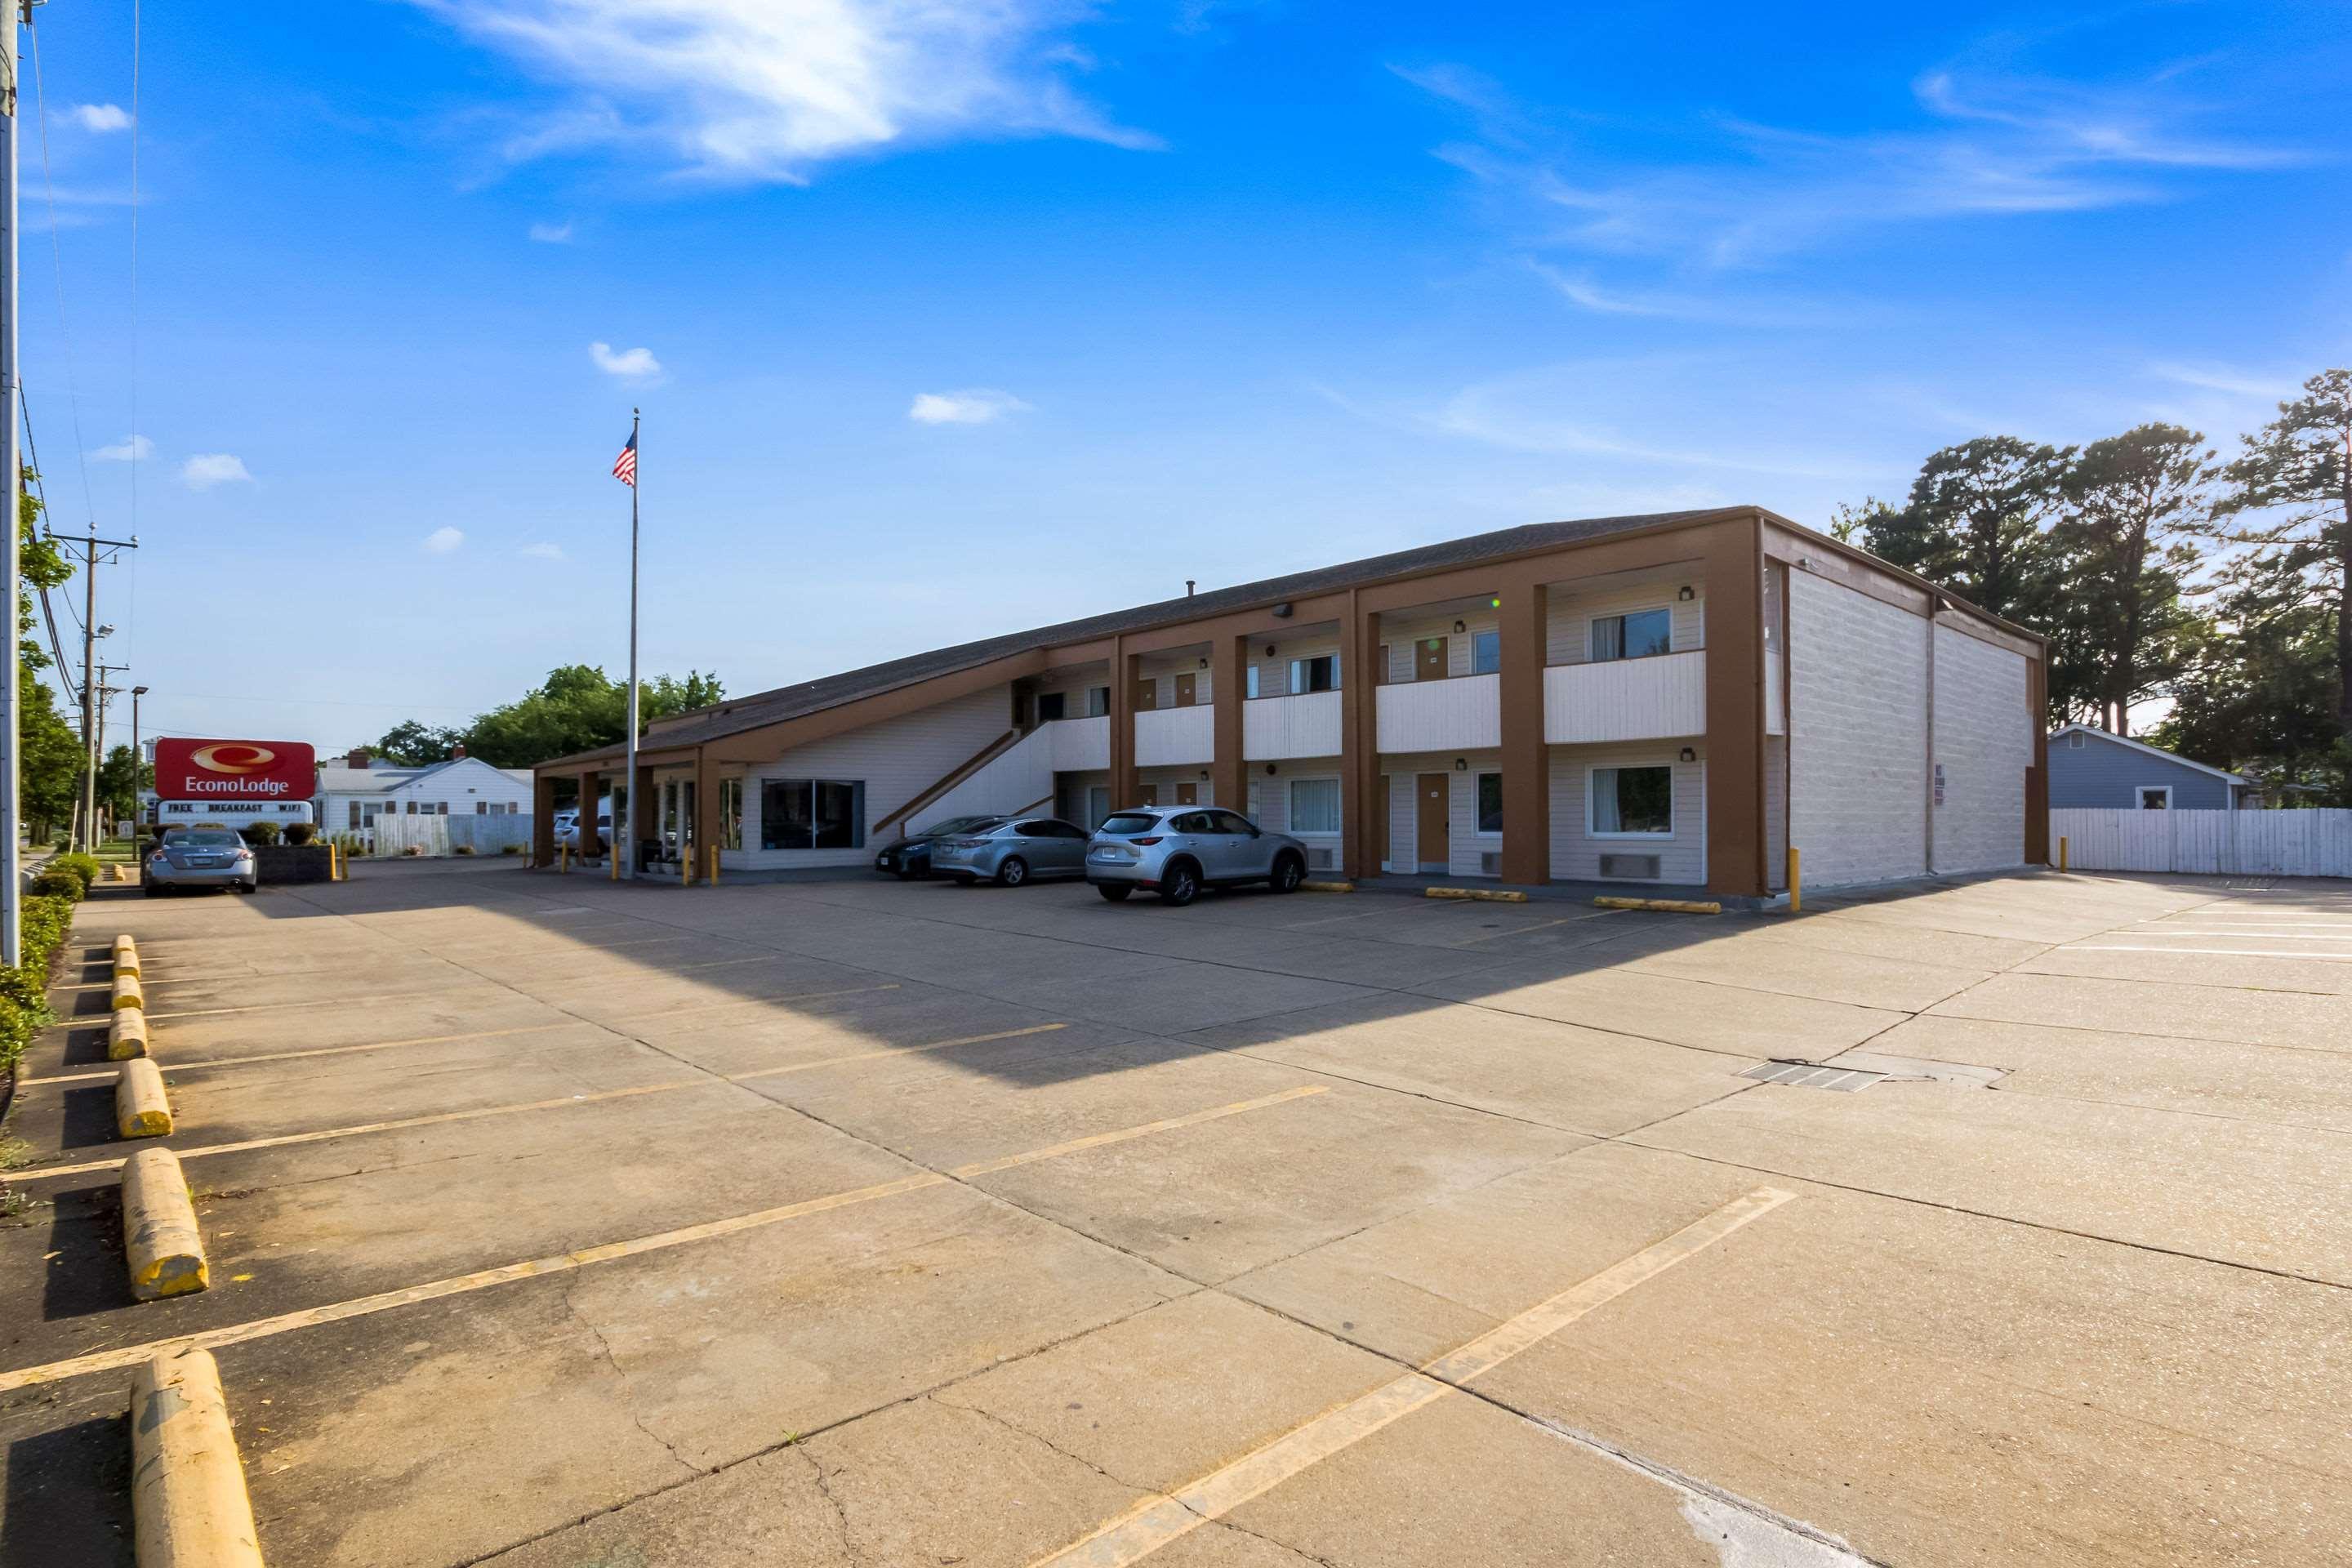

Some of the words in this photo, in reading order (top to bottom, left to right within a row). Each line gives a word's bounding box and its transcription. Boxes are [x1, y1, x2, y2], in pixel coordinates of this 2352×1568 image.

[185, 777, 289, 795] EconoLodge
[168, 804, 193, 813] FREE
[208, 804, 263, 813] BREAKFAST
[278, 804, 301, 813] WIFI
